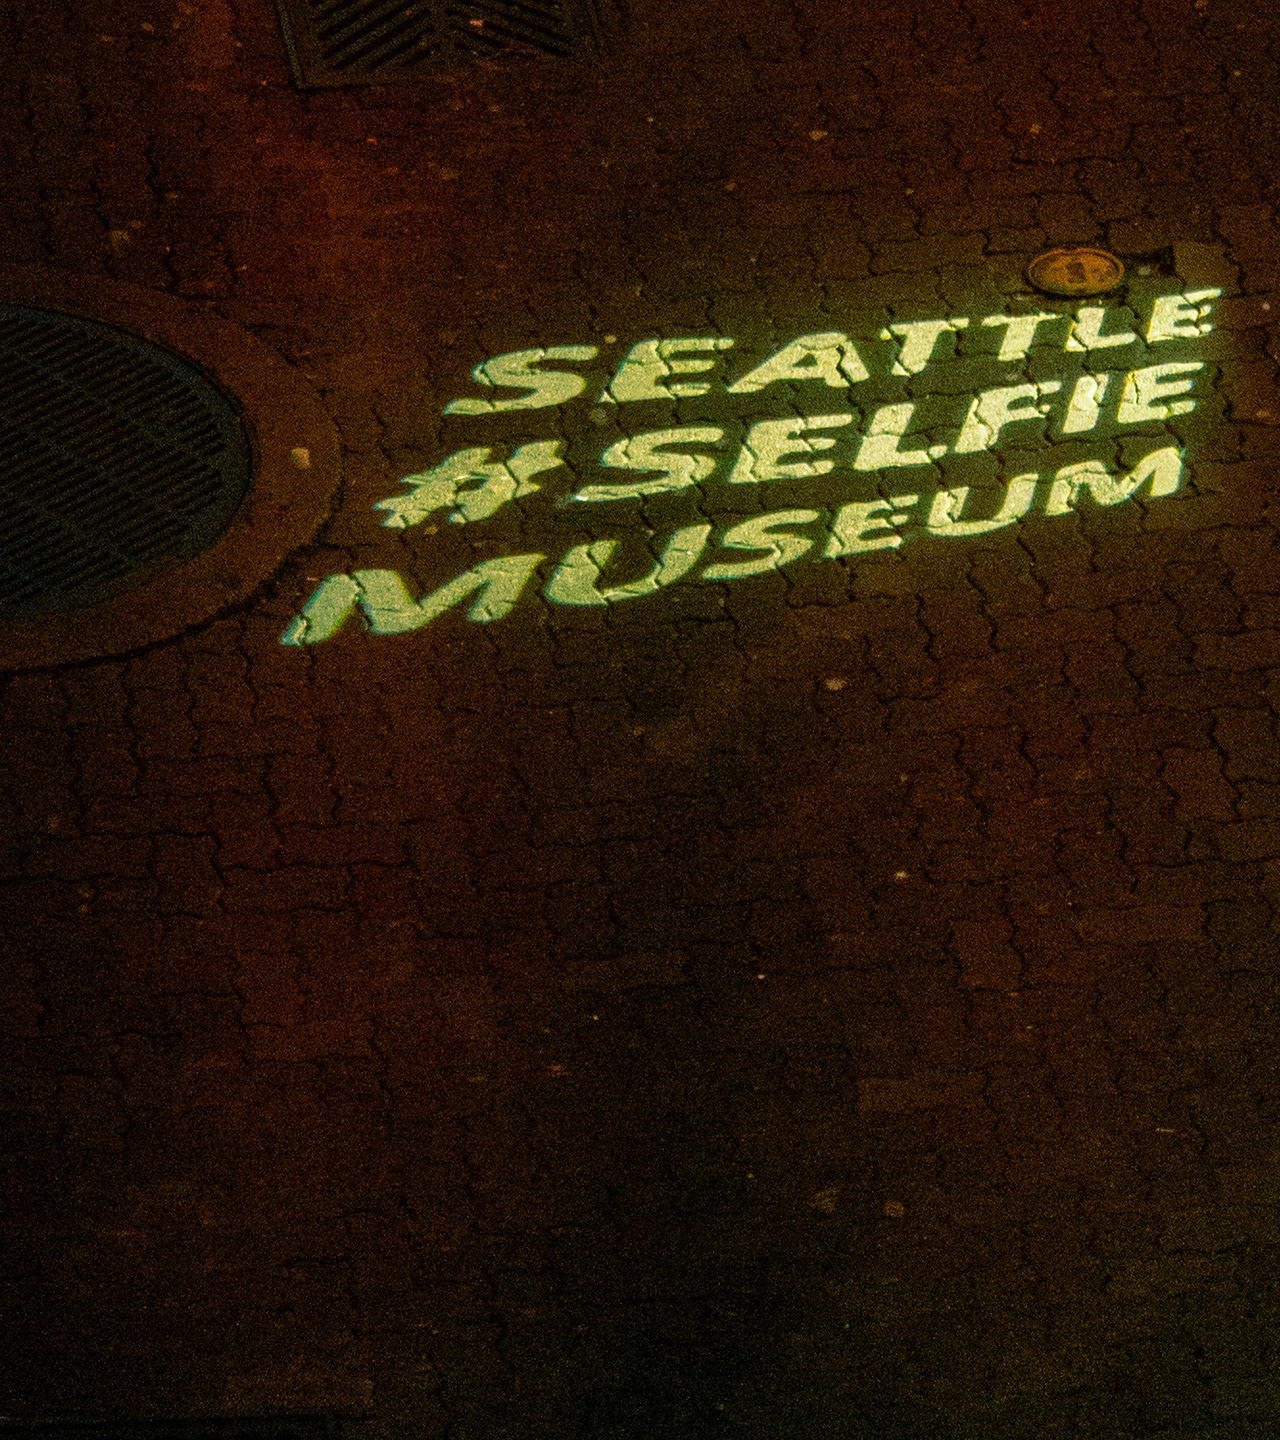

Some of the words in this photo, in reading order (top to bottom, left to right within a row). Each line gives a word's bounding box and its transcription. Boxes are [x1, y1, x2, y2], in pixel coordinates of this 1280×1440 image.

[442, 287, 1223, 417] SEATTLE
[373, 360, 1206, 528] #SELFIE
[277, 446, 1187, 646] MUSEUM
